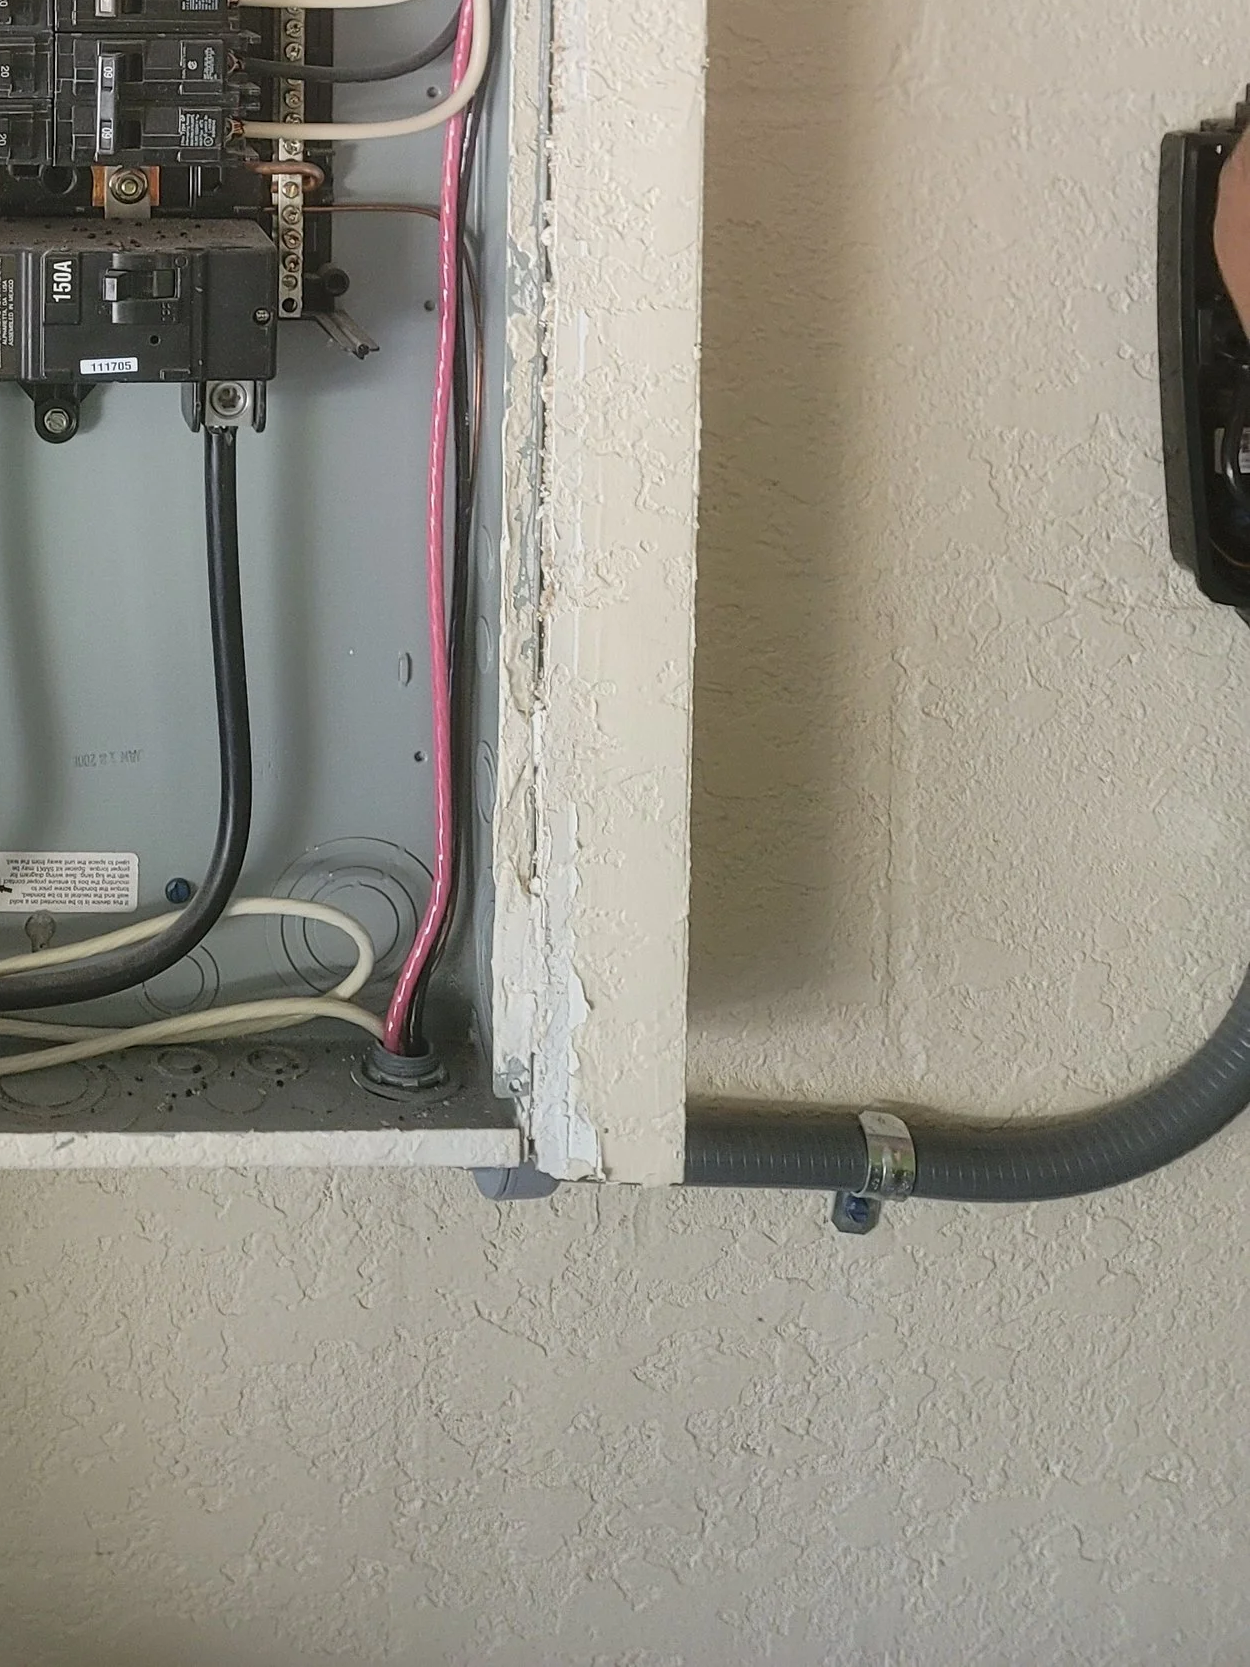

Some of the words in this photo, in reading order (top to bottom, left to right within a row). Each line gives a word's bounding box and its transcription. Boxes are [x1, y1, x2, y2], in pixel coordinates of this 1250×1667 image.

[1, 65, 9, 78] 20
[103, 66, 113, 78] 60
[102, 127, 112, 139] 60
[52, 260, 72, 303] 150A
[90, 360, 132, 372] 111705
